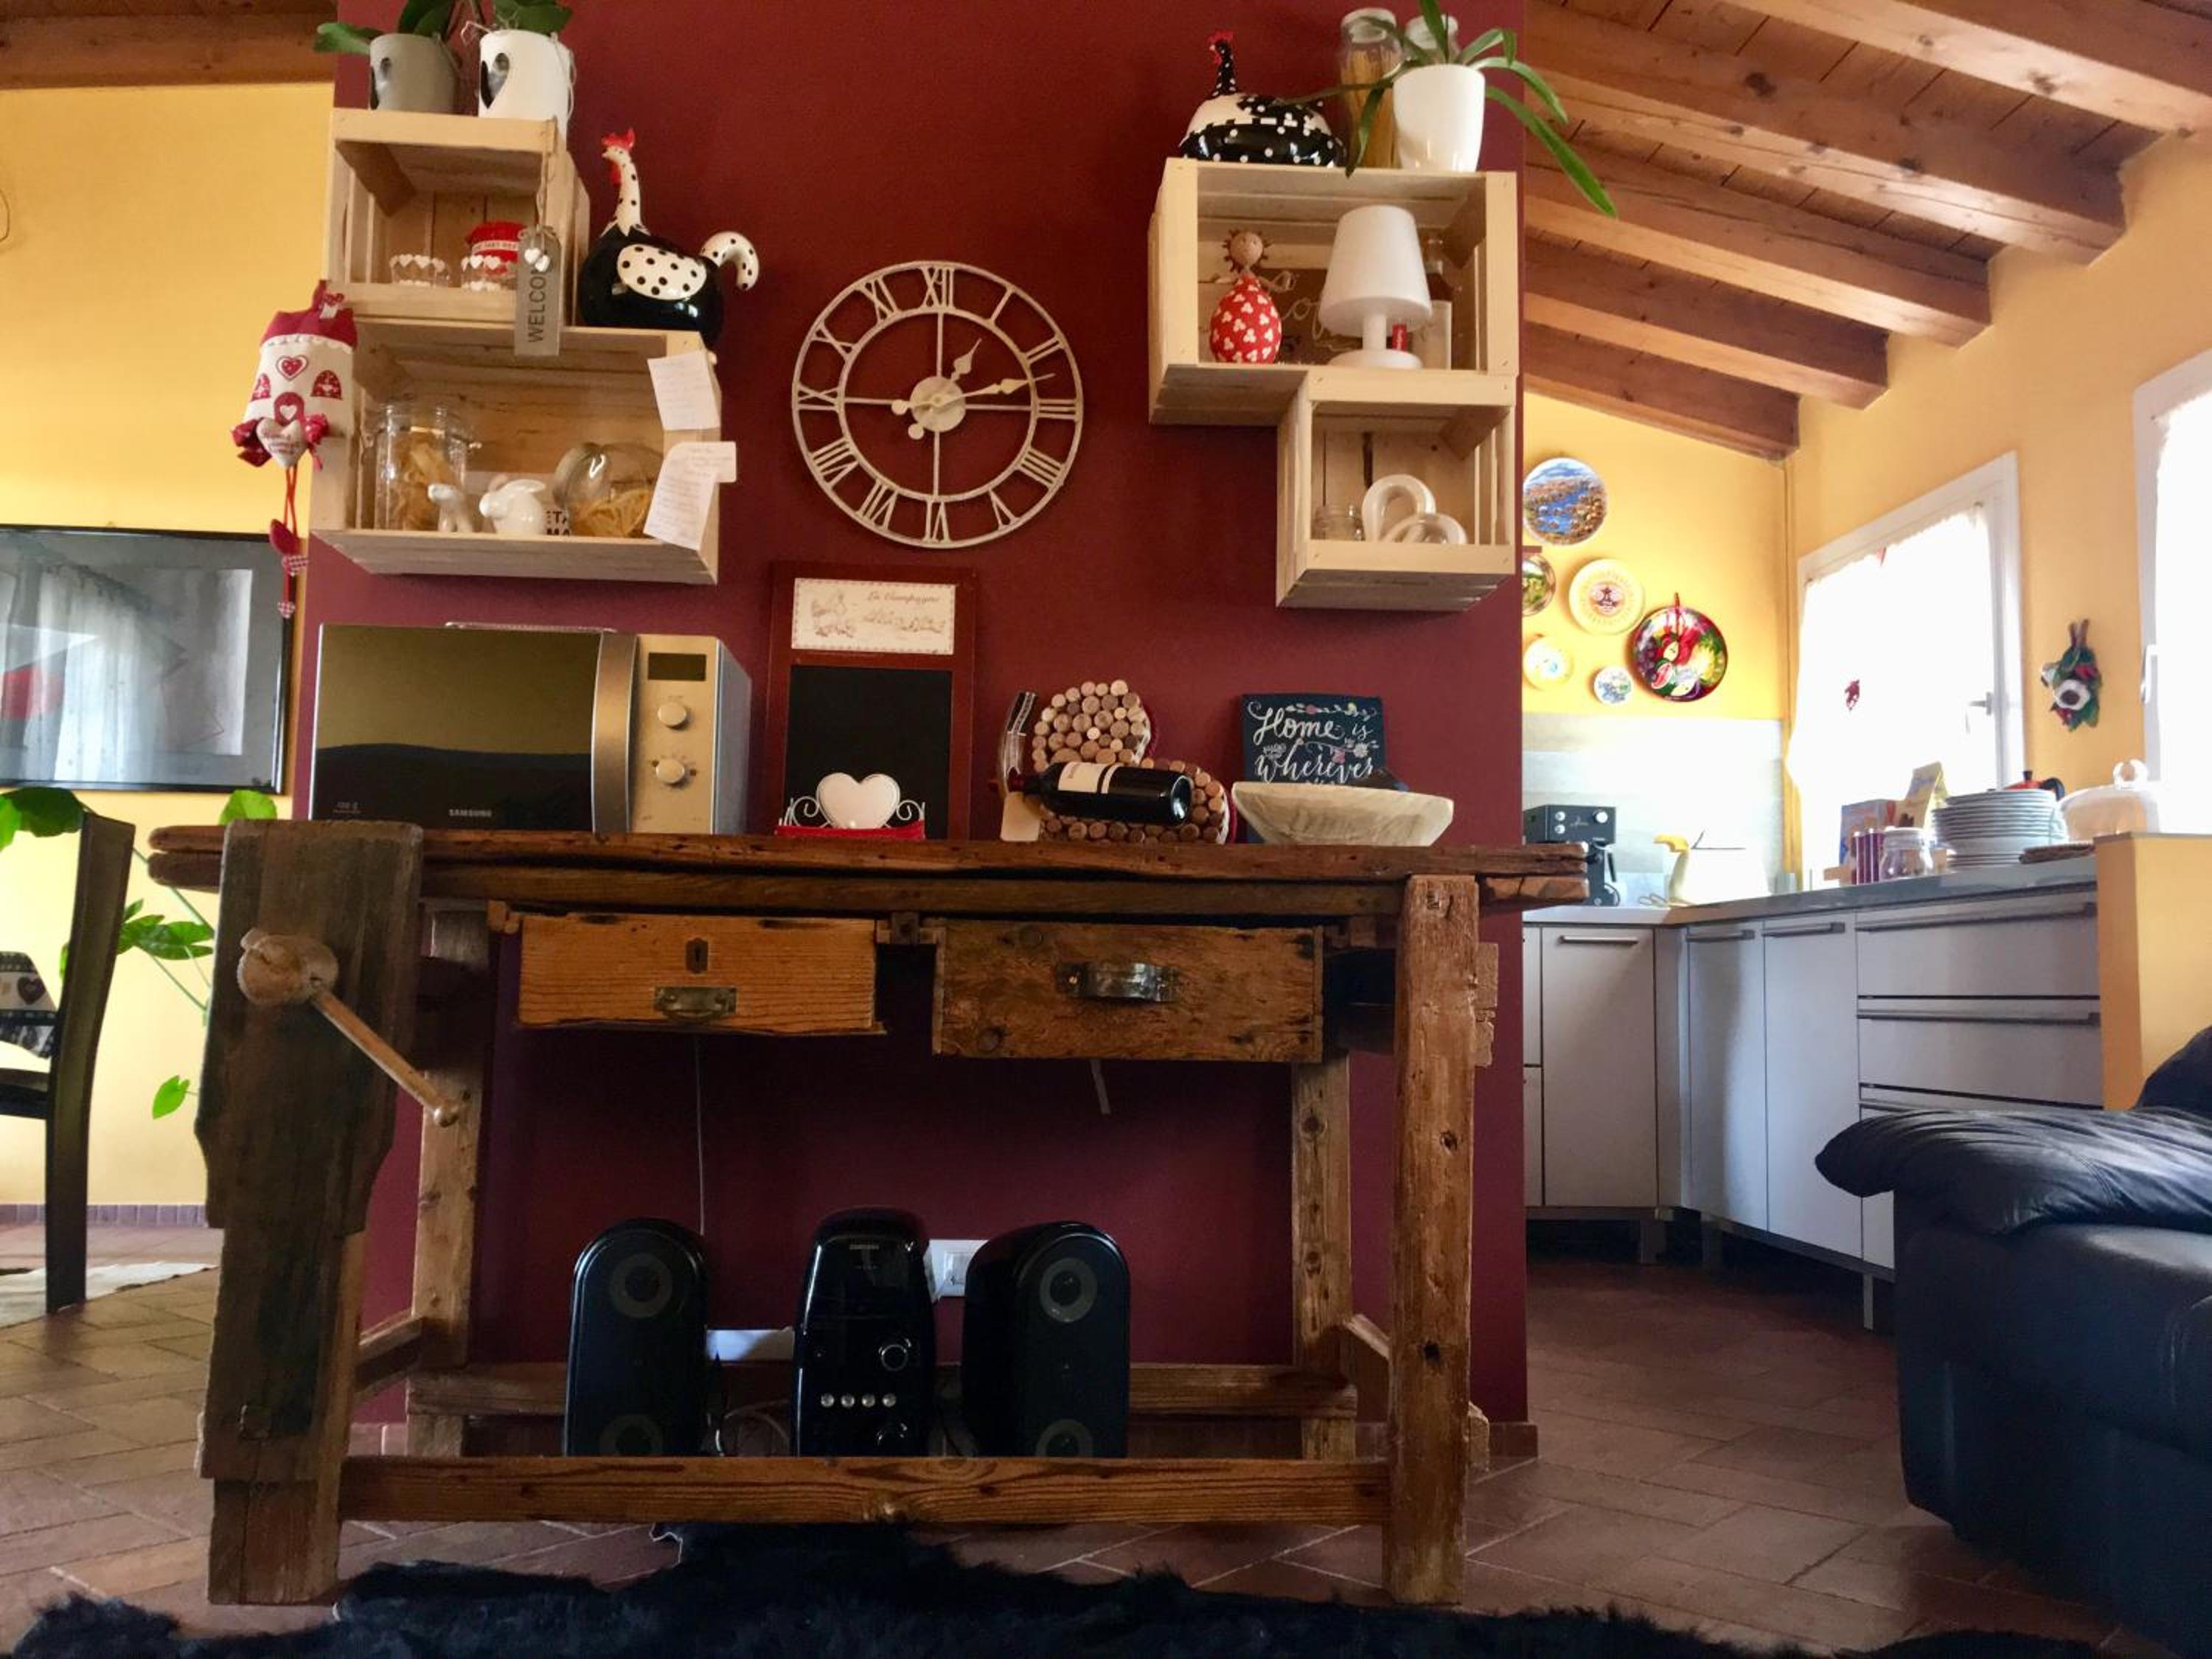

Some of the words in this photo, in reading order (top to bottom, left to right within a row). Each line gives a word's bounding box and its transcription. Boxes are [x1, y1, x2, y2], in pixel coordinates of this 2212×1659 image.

[810, 324, 856, 360] X
[1248, 701, 1346, 745] Home
[1352, 723, 1374, 741] is
[1255, 740, 1374, 784] Wherever
